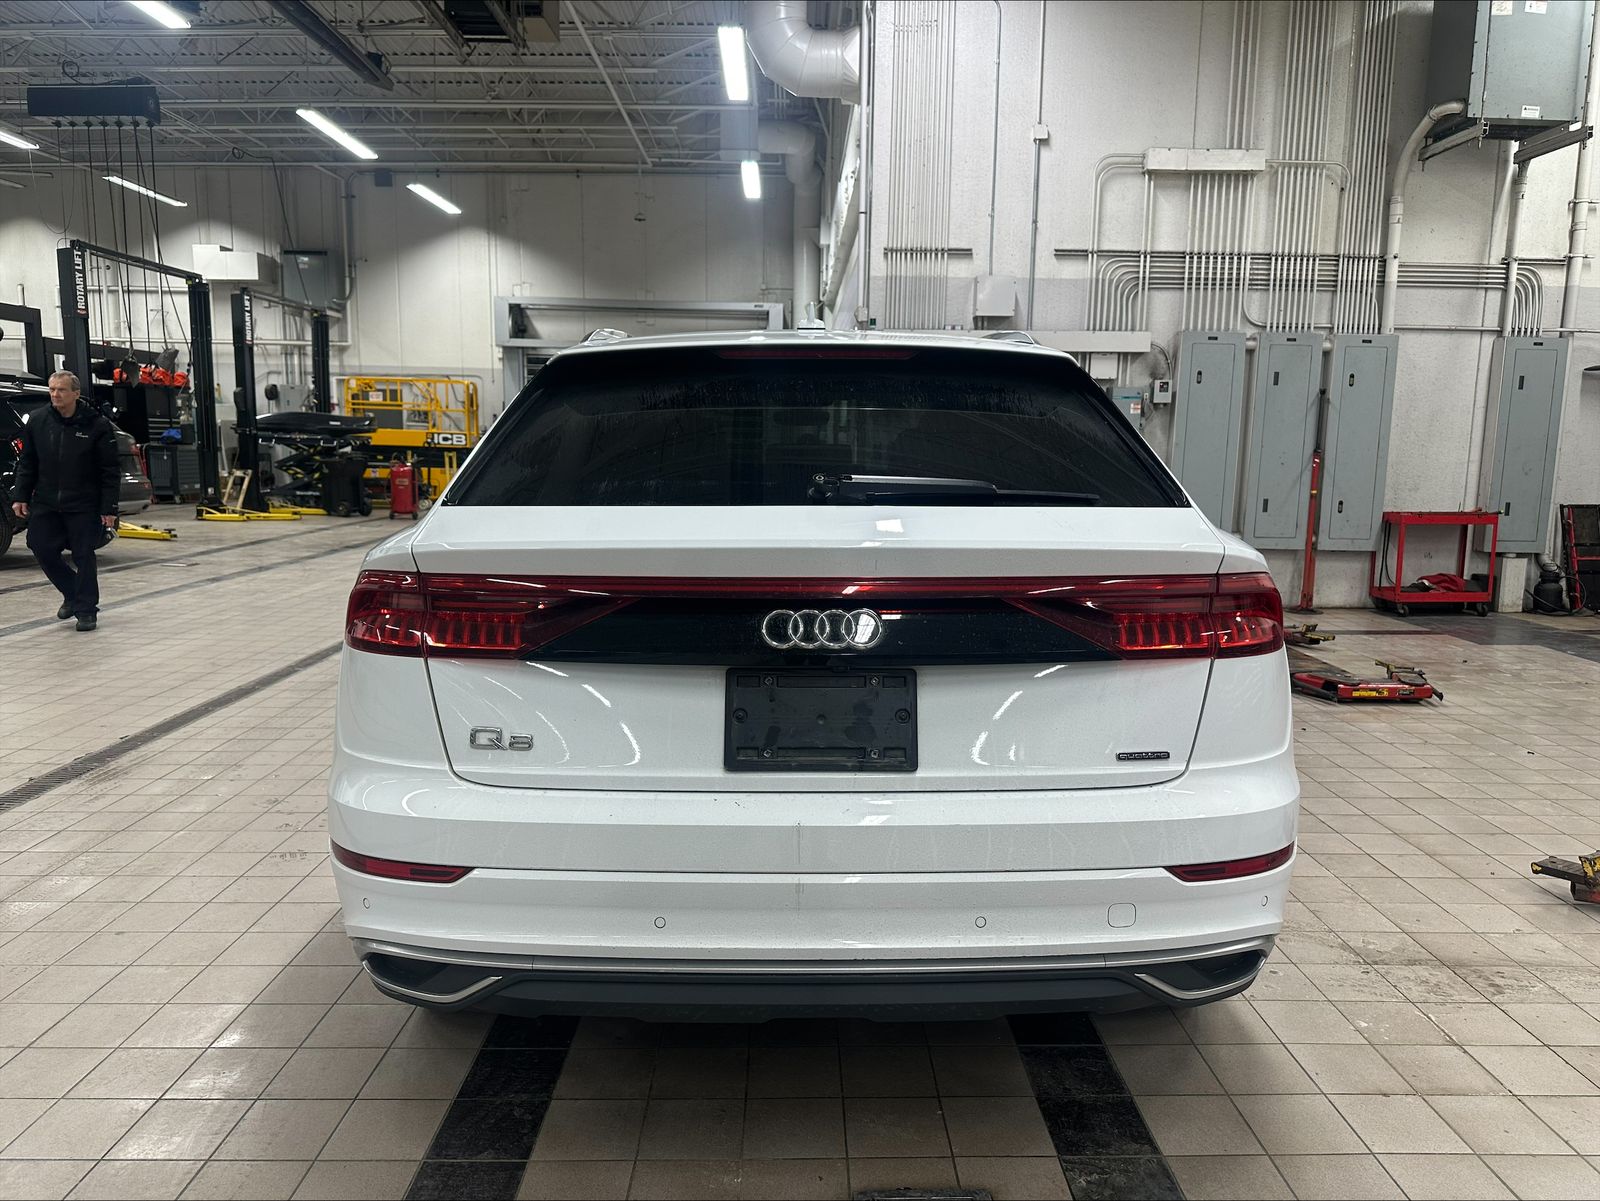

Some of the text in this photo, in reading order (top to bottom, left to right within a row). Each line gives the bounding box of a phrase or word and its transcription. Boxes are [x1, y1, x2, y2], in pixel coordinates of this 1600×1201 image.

[73, 249, 86, 309] ROTARY LIFT
[470, 726, 533, 751] Q8
[1119, 752, 1169, 761] quattro
